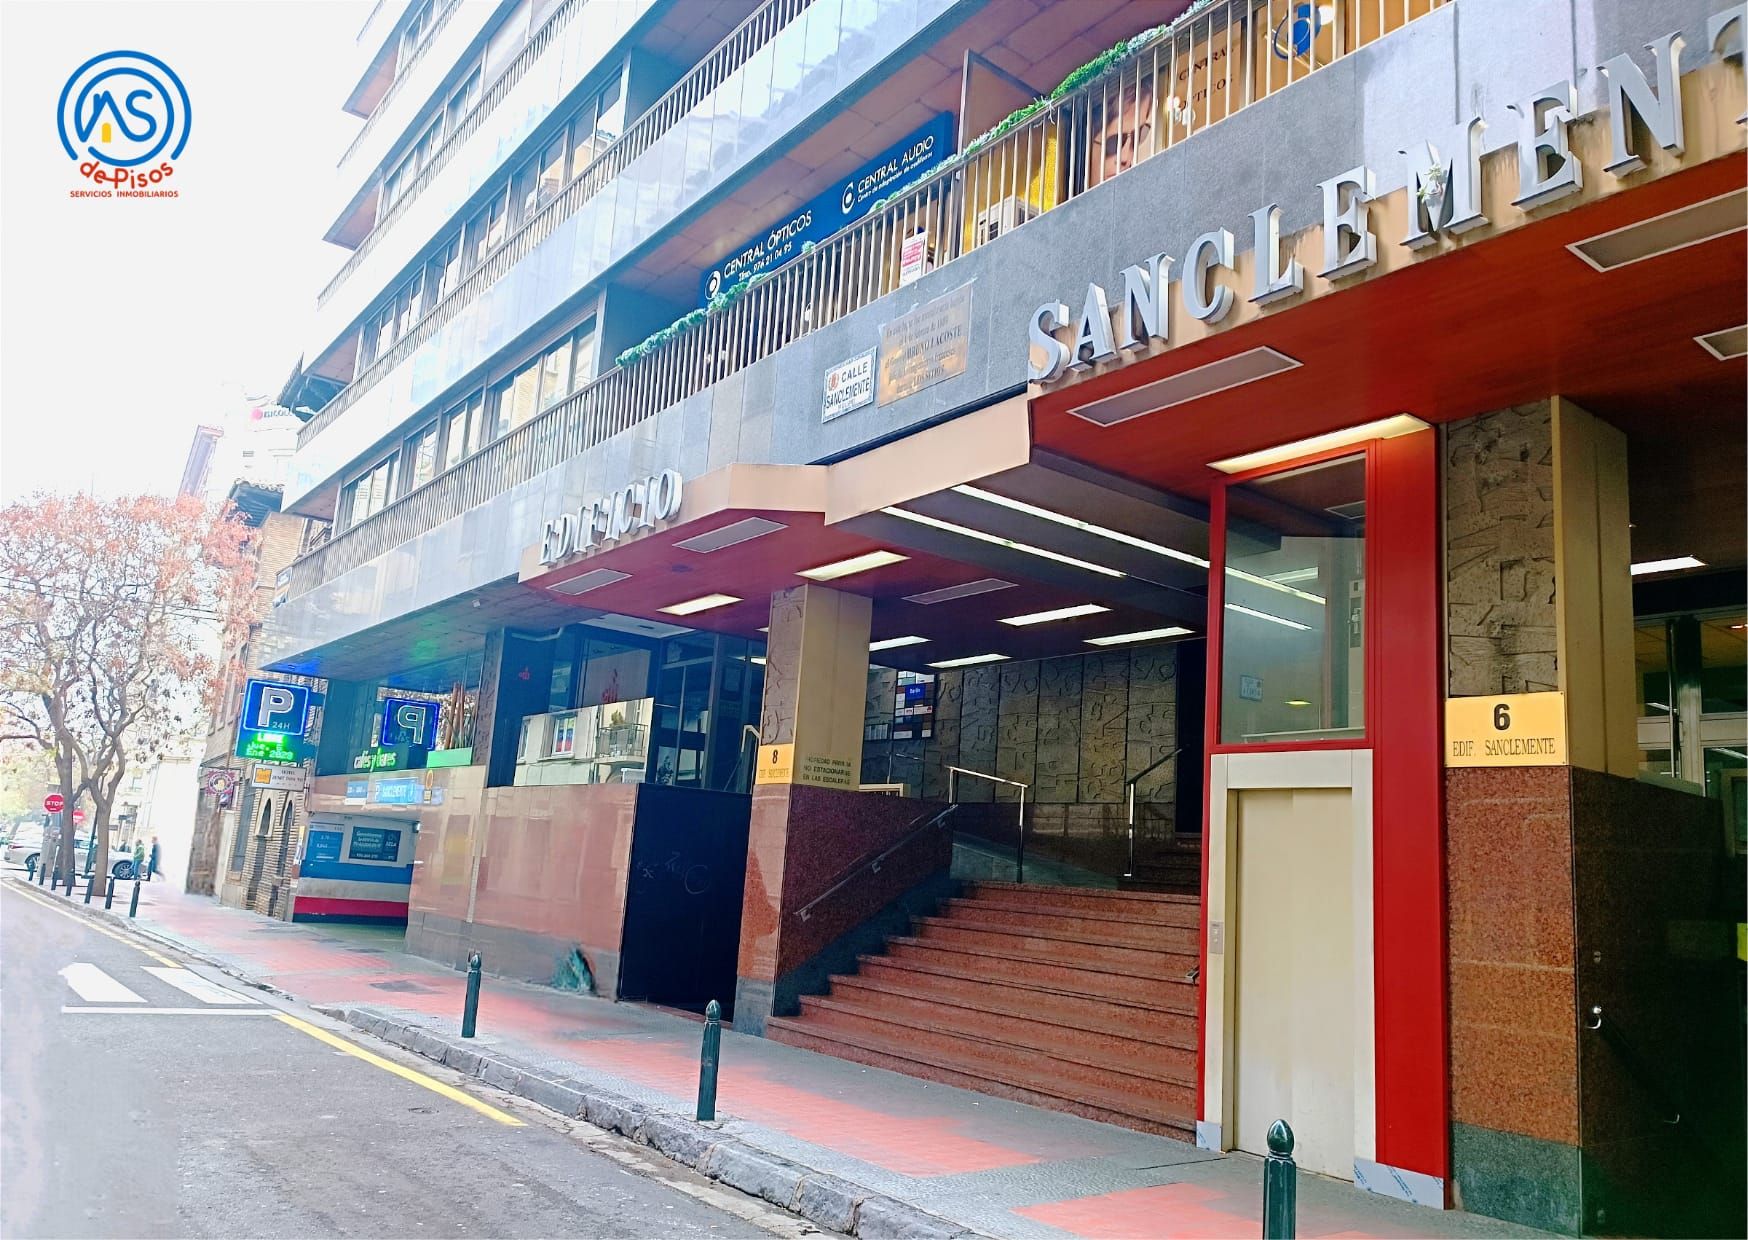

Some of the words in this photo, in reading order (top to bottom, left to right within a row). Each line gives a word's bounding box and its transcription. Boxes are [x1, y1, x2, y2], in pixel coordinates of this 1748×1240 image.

[857, 159, 898, 193] CENTRAL
[901, 135, 934, 166] AUDIO
[724, 241, 765, 278] CENTRAL
[767, 209, 812, 251] ÓPTICOS
[931, 325, 962, 349] LACOSTE
[841, 362, 869, 383] CALLE
[826, 377, 870, 409] SANCLEMENTE
[539, 468, 683, 567] EDIFICIO
[258, 687, 294, 727] P
[1493, 703, 1511, 731] 6
[772, 749, 779, 764] 8
[1485, 737, 1556, 756] SANCLEMENTE
